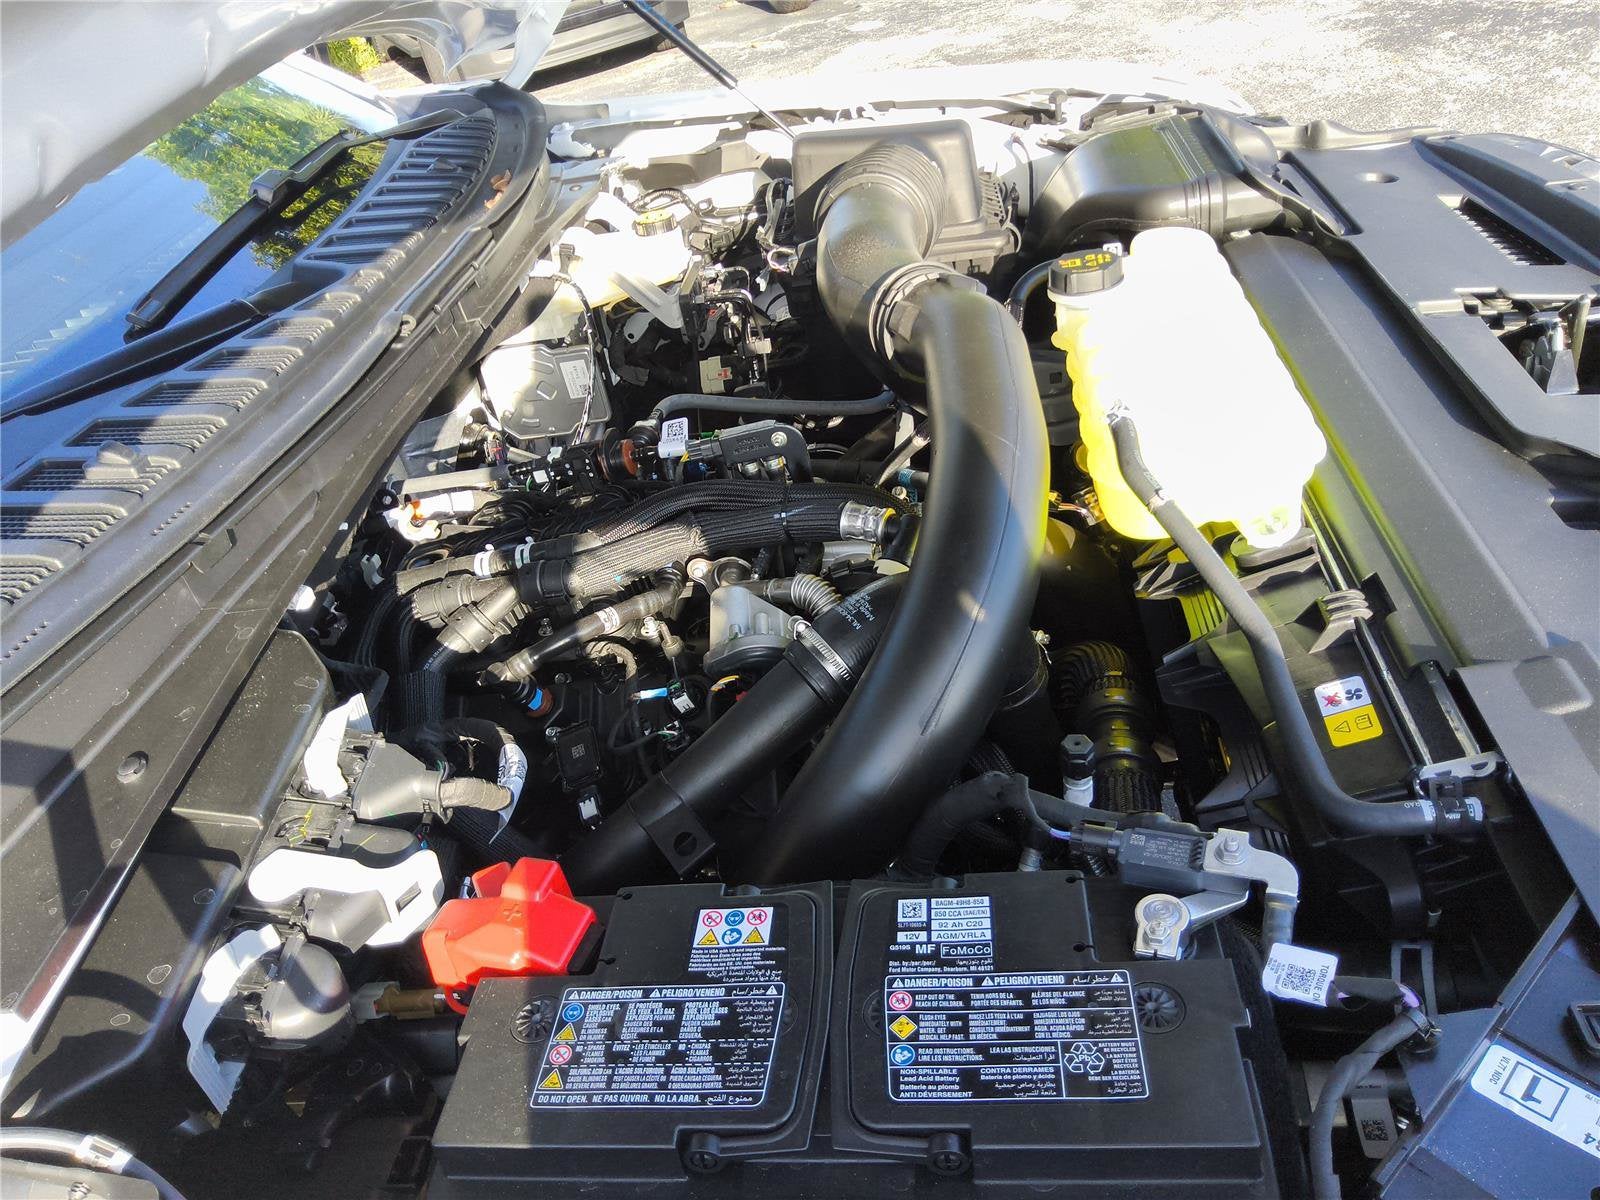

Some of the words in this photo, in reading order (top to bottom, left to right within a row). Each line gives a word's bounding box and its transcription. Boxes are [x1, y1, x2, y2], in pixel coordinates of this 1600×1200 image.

[916, 944, 936, 954] MF
[942, 946, 990, 955] FoMoCo
[905, 978, 973, 987] DANGER/POISON
[994, 975, 1065, 986] PELIGRO/VENENO
[1314, 965, 1329, 991] TORQUE
[580, 990, 643, 999] DANGER/POISON
[662, 988, 725, 997] PELIGRO/VENENO
[1490, 1070, 1502, 1085] NDC
[729, 1095, 753, 1104] ممنوع
